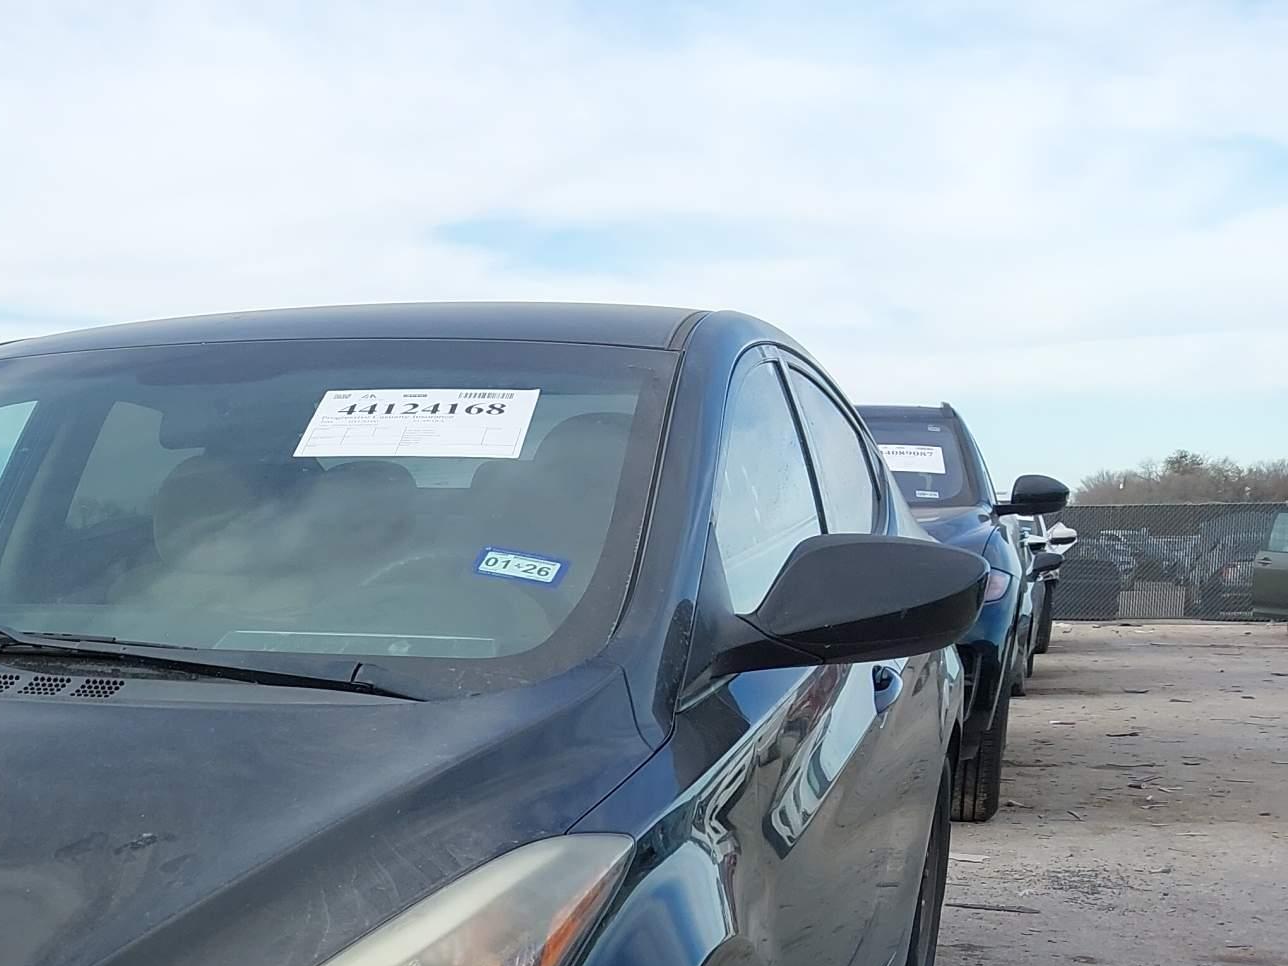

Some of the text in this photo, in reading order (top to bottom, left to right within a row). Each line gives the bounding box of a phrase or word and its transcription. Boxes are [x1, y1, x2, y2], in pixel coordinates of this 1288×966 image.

[337, 402, 507, 416] 44124168
[484, 557, 552, 577] 01 26
